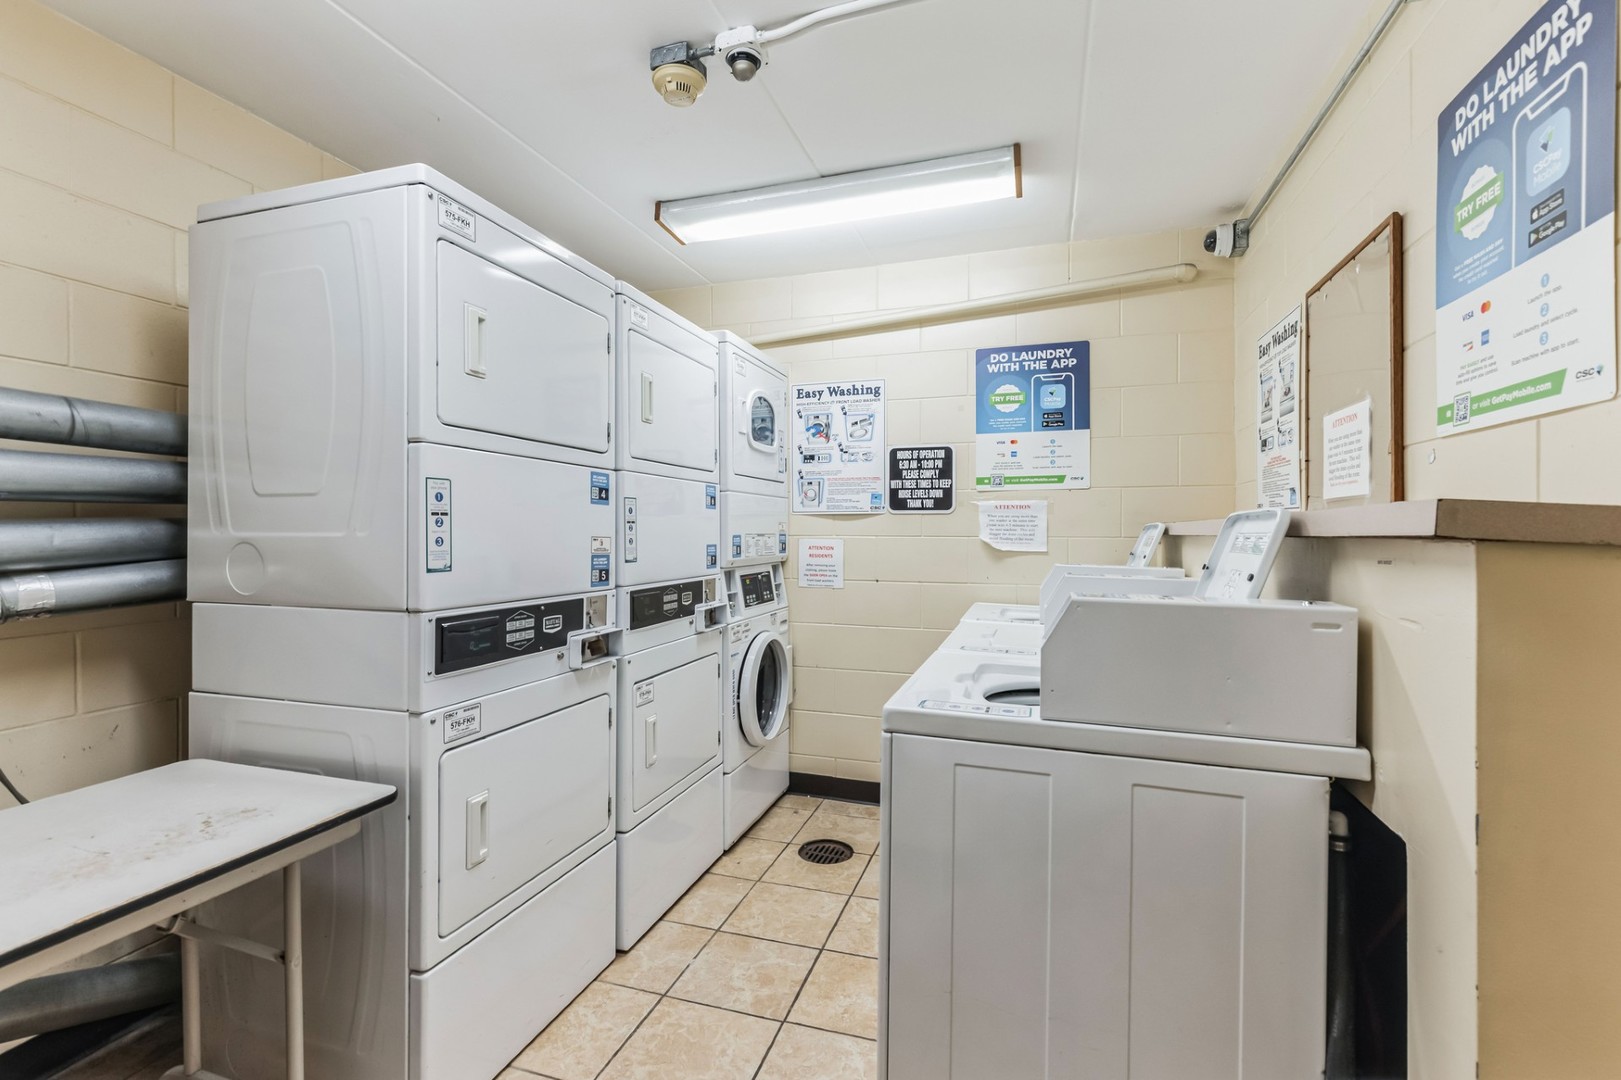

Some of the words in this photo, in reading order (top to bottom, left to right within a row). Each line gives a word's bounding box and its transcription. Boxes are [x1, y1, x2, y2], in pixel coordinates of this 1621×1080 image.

[1455, 94, 1479, 132] DO
[1483, 0, 1581, 105] LAUNDRY
[1451, 101, 1495, 157] WITH
[1499, 60, 1538, 114] THE
[1543, 12, 1593, 77] APP
[1456, 201, 1475, 223] TRY
[1476, 181, 1502, 210] FREE
[445, 209, 471, 228] 575-FKH
[1462, 310, 1474, 322] VISA
[1258, 341, 1271, 360] Easy
[1272, 320, 1298, 349] Washing
[990, 352, 1008, 362] DO
[1012, 348, 1073, 362] LAUNDRY
[987, 362, 1020, 373] WITH
[1022, 360, 1048, 370] THE
[1050, 358, 1077, 369] APP
[1576, 367, 1594, 379] CSC
[796, 388, 824, 401] Easy
[827, 384, 881, 397] Washing
[1480, 398, 1490, 408] visit
[1491, 382, 1552, 405] GetPayMobile.com
[1332, 412, 1358, 428] ATTENTION
[897, 450, 912, 459] HOURS
[912, 450, 918, 459] OF
[919, 449, 945, 458] OPERATION
[910, 460, 917, 468] AM
[921, 460, 934, 468] 10:00
[935, 459, 942, 468] PM
[902, 470, 919, 479] PLEASE
[920, 469, 939, 478] COMPLY
[890, 480, 902, 488] WITH
[902, 480, 916, 488] THESE
[917, 480, 931, 488] TIMES
[932, 479, 939, 488] TO
[940, 479, 952, 488] KEEP
[601, 490, 606, 498] 4
[898, 490, 911, 498] NOISE
[912, 489, 928, 498] LEVELS
[929, 489, 943, 498] DOWN
[907, 499, 922, 508] THANK
[601, 571, 606, 580] 5
[450, 716, 475, 730] 576-FKH
